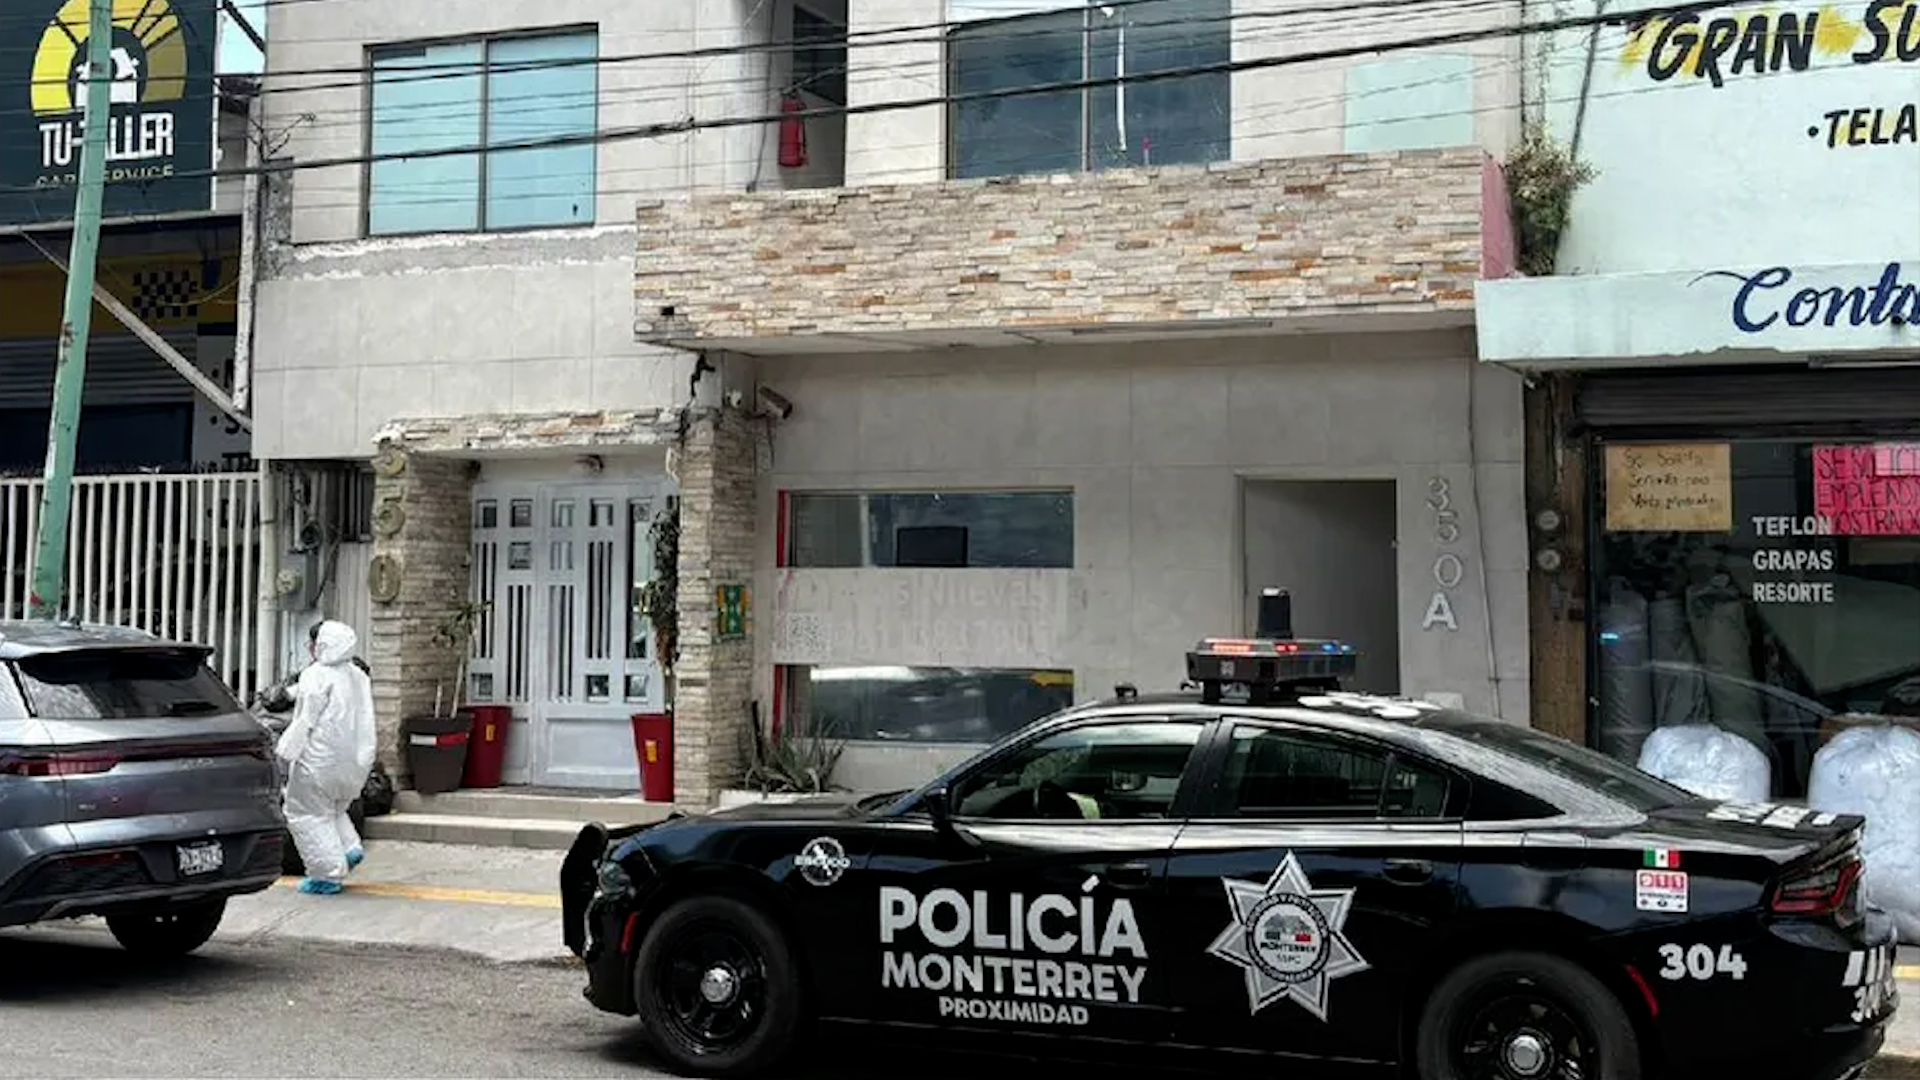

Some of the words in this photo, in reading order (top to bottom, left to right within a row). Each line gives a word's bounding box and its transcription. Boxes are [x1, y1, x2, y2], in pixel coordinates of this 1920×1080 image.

[1648, 12, 1819, 88] GRAN
[1751, 515, 1833, 536] TEFLON
[1752, 549, 1835, 571] GRAPAS
[1752, 582, 1835, 603] RESORTE
[879, 874, 1149, 959] POLICÍA
[881, 951, 1148, 1004] MONTERREY
[1658, 943, 1748, 981] 304
[938, 996, 1090, 1026] PROXIMIDAD
